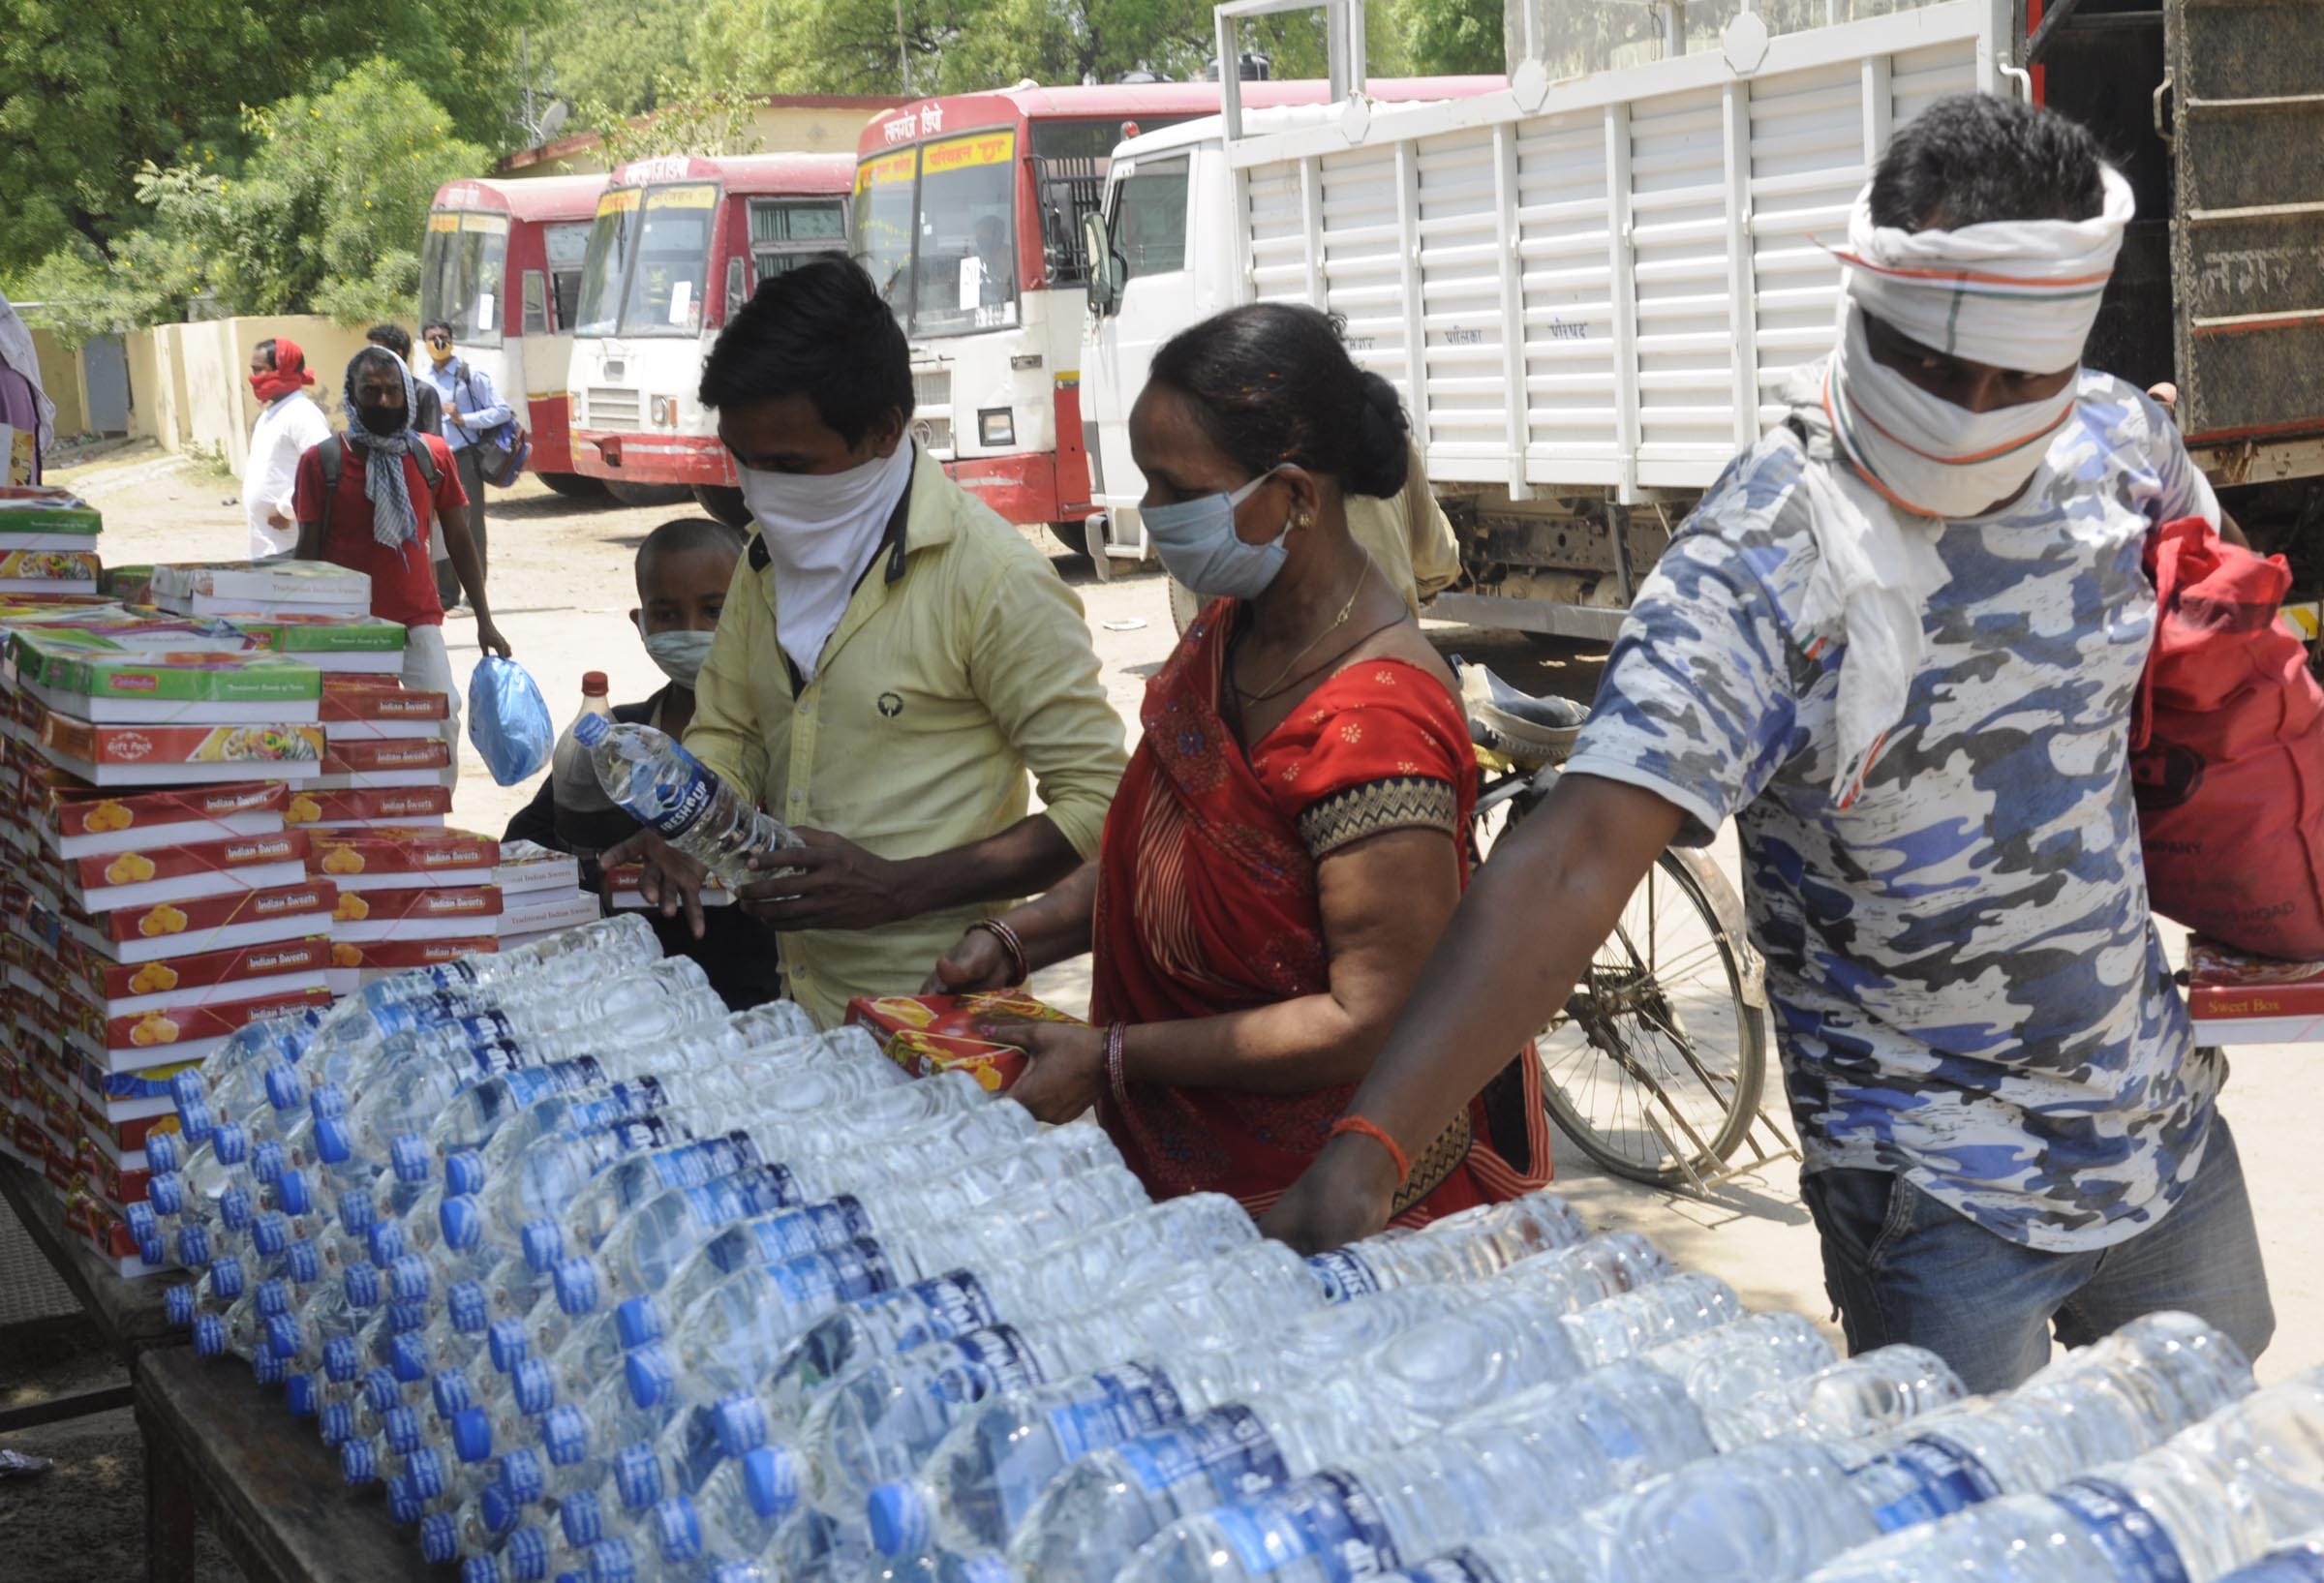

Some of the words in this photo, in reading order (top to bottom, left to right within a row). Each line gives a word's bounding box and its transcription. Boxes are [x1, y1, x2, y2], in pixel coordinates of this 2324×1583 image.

[206, 798, 234, 809] Indian
[228, 846, 256, 859] Indian
[258, 841, 290, 854] Sweets
[426, 853, 451, 862] Indian
[257, 897, 285, 910] Indian
[287, 893, 317, 906] Sweets
[429, 898, 456, 908] Indian
[456, 897, 483, 907] Sweets
[250, 956, 278, 968] Indian
[279, 952, 308, 964] Sweets
